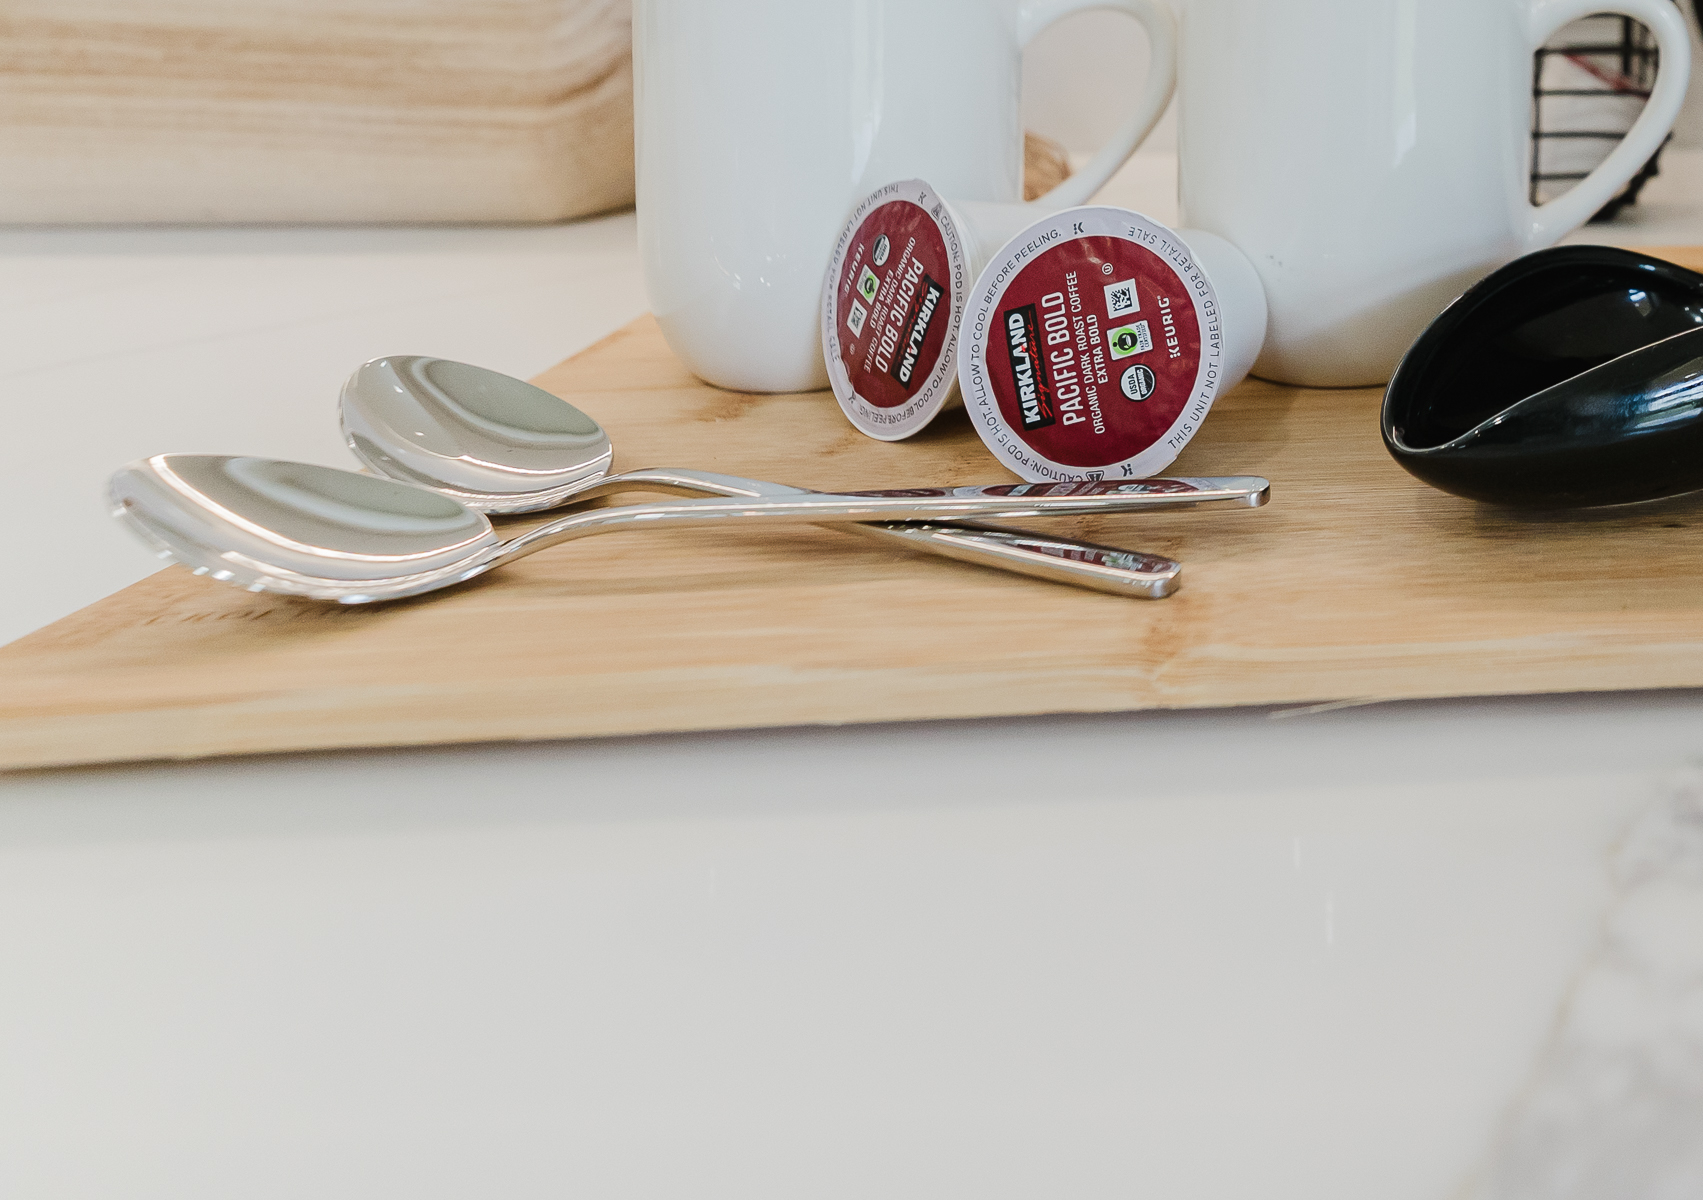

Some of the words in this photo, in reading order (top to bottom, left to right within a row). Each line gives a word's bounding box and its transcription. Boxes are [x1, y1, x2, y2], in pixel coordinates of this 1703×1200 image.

[854, 202, 867, 221] NOT
[867, 190, 883, 206] UNIT
[1014, 229, 1061, 262] PEELING.
[1128, 226, 1157, 245] SALE
[895, 236, 916, 279] ORGANIC
[1160, 239, 1193, 272] RETAIL
[878, 269, 894, 301] EXTRA
[885, 279, 898, 306] DARK
[889, 256, 924, 327] PACIFIC
[954, 264, 963, 289] POD
[984, 260, 1016, 304] BEFORE
[1065, 270, 1081, 313] COFFEE
[1190, 272, 1208, 297] FOR
[955, 292, 963, 303] IS
[870, 301, 882, 328] BOLD
[875, 305, 889, 337] ROAST
[973, 307, 988, 340] COOL
[1041, 291, 1070, 346] BOLD
[1086, 314, 1101, 345] BOLD
[1203, 300, 1220, 357] LABELED
[875, 324, 899, 373] BOLD
[900, 286, 940, 382] KIRKLAND
[1072, 316, 1088, 351] ROAST
[863, 337, 878, 373] COFFEE
[940, 334, 956, 375] ALLOW
[971, 344, 980, 361] TO
[1008, 312, 1041, 423] KIRKLAND
[1081, 352, 1094, 384] DARK
[1093, 346, 1108, 384] EXTRA
[932, 374, 942, 388] TO
[971, 364, 988, 406] ALLOW
[1050, 347, 1086, 426] PACIFIC
[1127, 373, 1138, 395] USDA
[1204, 362, 1218, 389] NOT
[888, 406, 914, 424] BEFORE
[914, 388, 933, 410] COOL
[1086, 385, 1106, 434] ORGANIC
[1190, 392, 1209, 421] UNIT
[983, 407, 1002, 435] HOT.
[1168, 423, 1192, 449] THIS
[998, 433, 1010, 447] IS
[1007, 444, 1030, 466] POD
